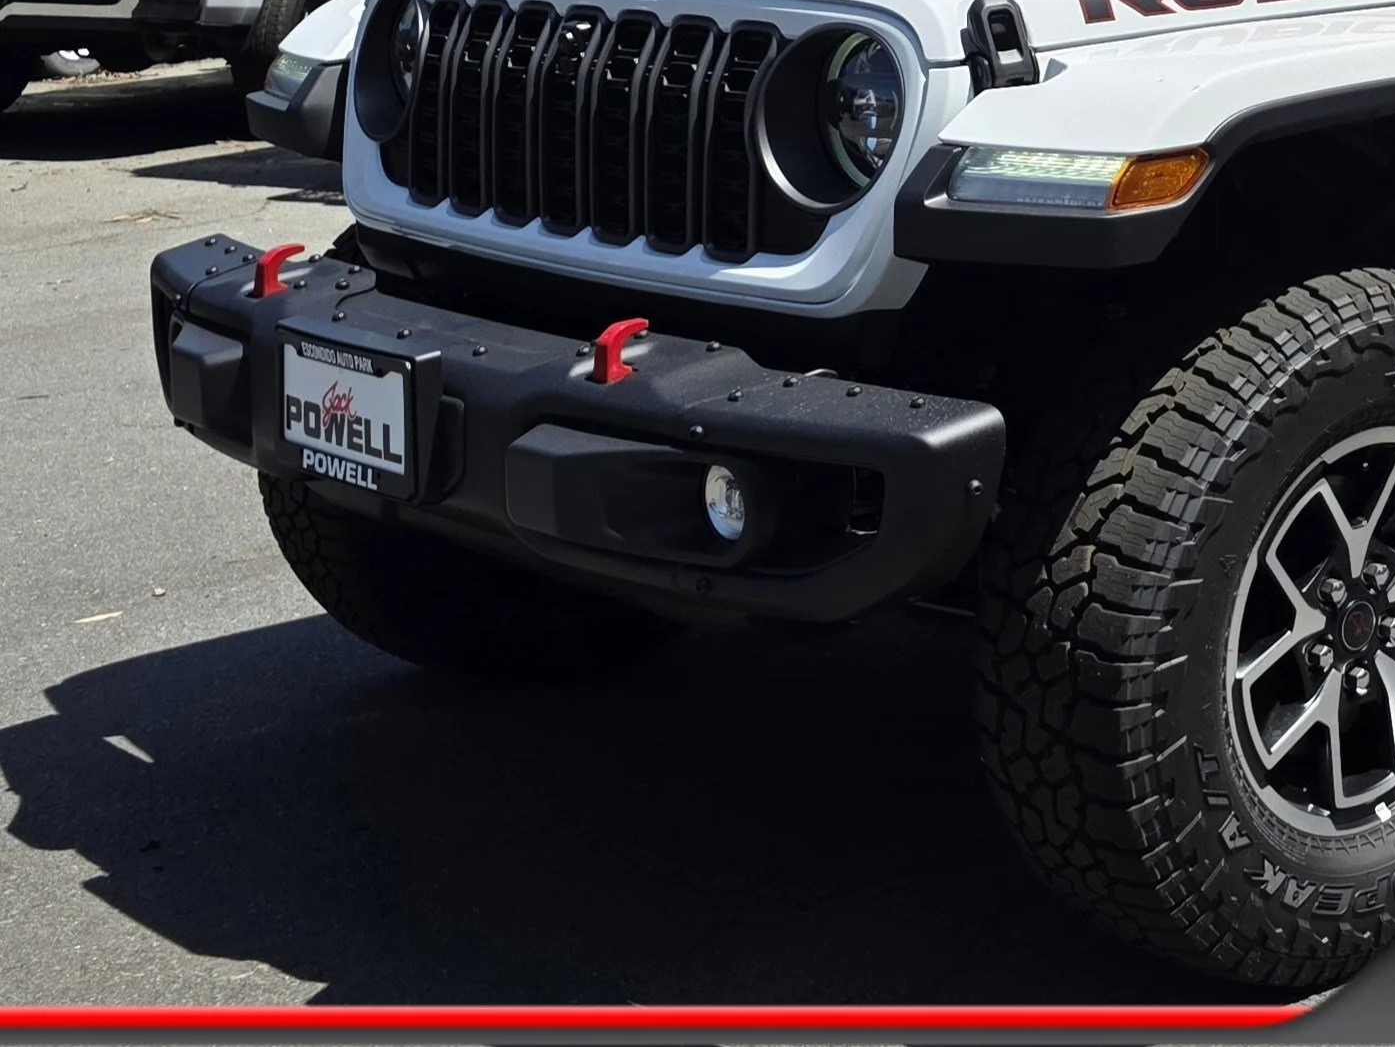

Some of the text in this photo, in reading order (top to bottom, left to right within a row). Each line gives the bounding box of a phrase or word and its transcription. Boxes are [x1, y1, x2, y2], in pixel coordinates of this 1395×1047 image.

[301, 341, 374, 374] ESCONDIDO AUTO PARK
[321, 380, 357, 430] Jack
[286, 393, 403, 465] POWELL
[302, 448, 378, 491] POWELL
